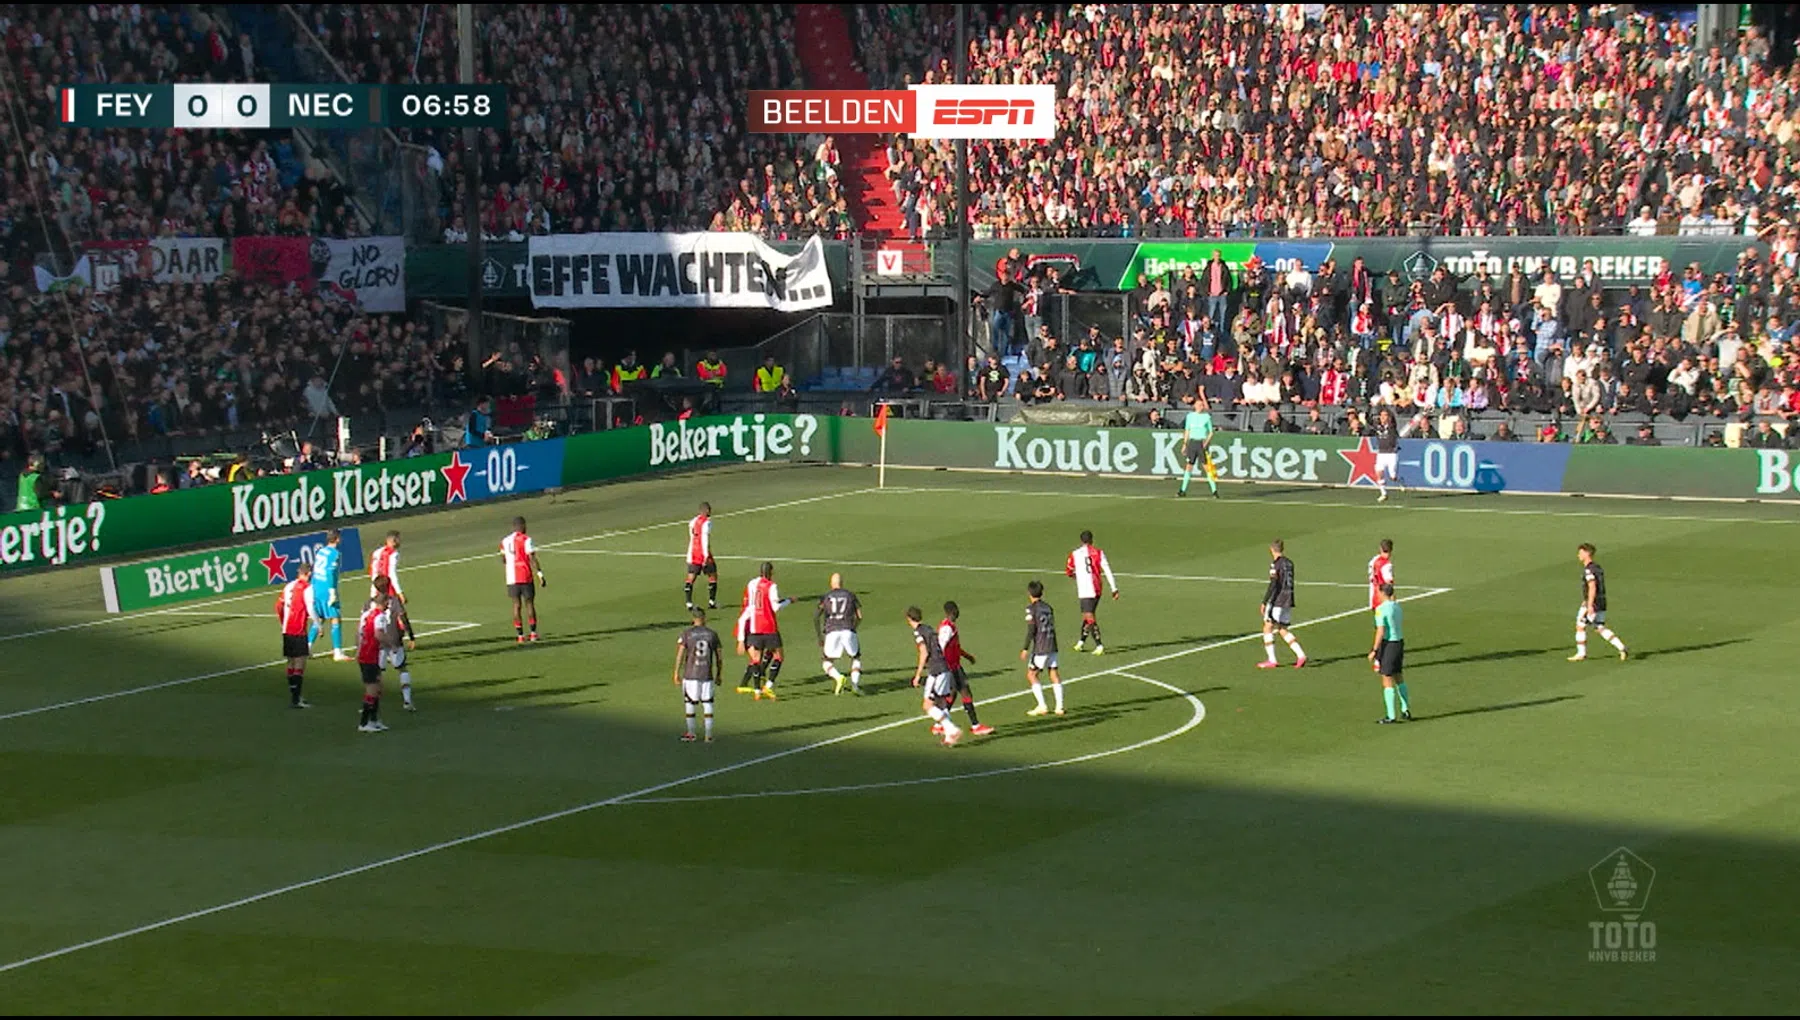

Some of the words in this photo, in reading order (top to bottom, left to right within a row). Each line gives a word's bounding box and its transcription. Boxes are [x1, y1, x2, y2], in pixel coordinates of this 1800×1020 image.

[338, 263, 399, 289] GLORY
[352, 245, 380, 266] NO
[532, 255, 609, 296] EFFE
[882, 254, 897, 271] V
[649, 413, 818, 465] Bekertje?
[994, 426, 1138, 473] Koude
[1152, 432, 1327, 480] Ketser
[1424, 443, 1476, 486] 0.0
[232, 476, 326, 533] Koude
[333, 467, 436, 518] Kletser
[0, 501, 105, 564] ertje?
[145, 552, 249, 597] Biertje?
[829, 597, 847, 613] 17
[695, 640, 708, 657] 9
